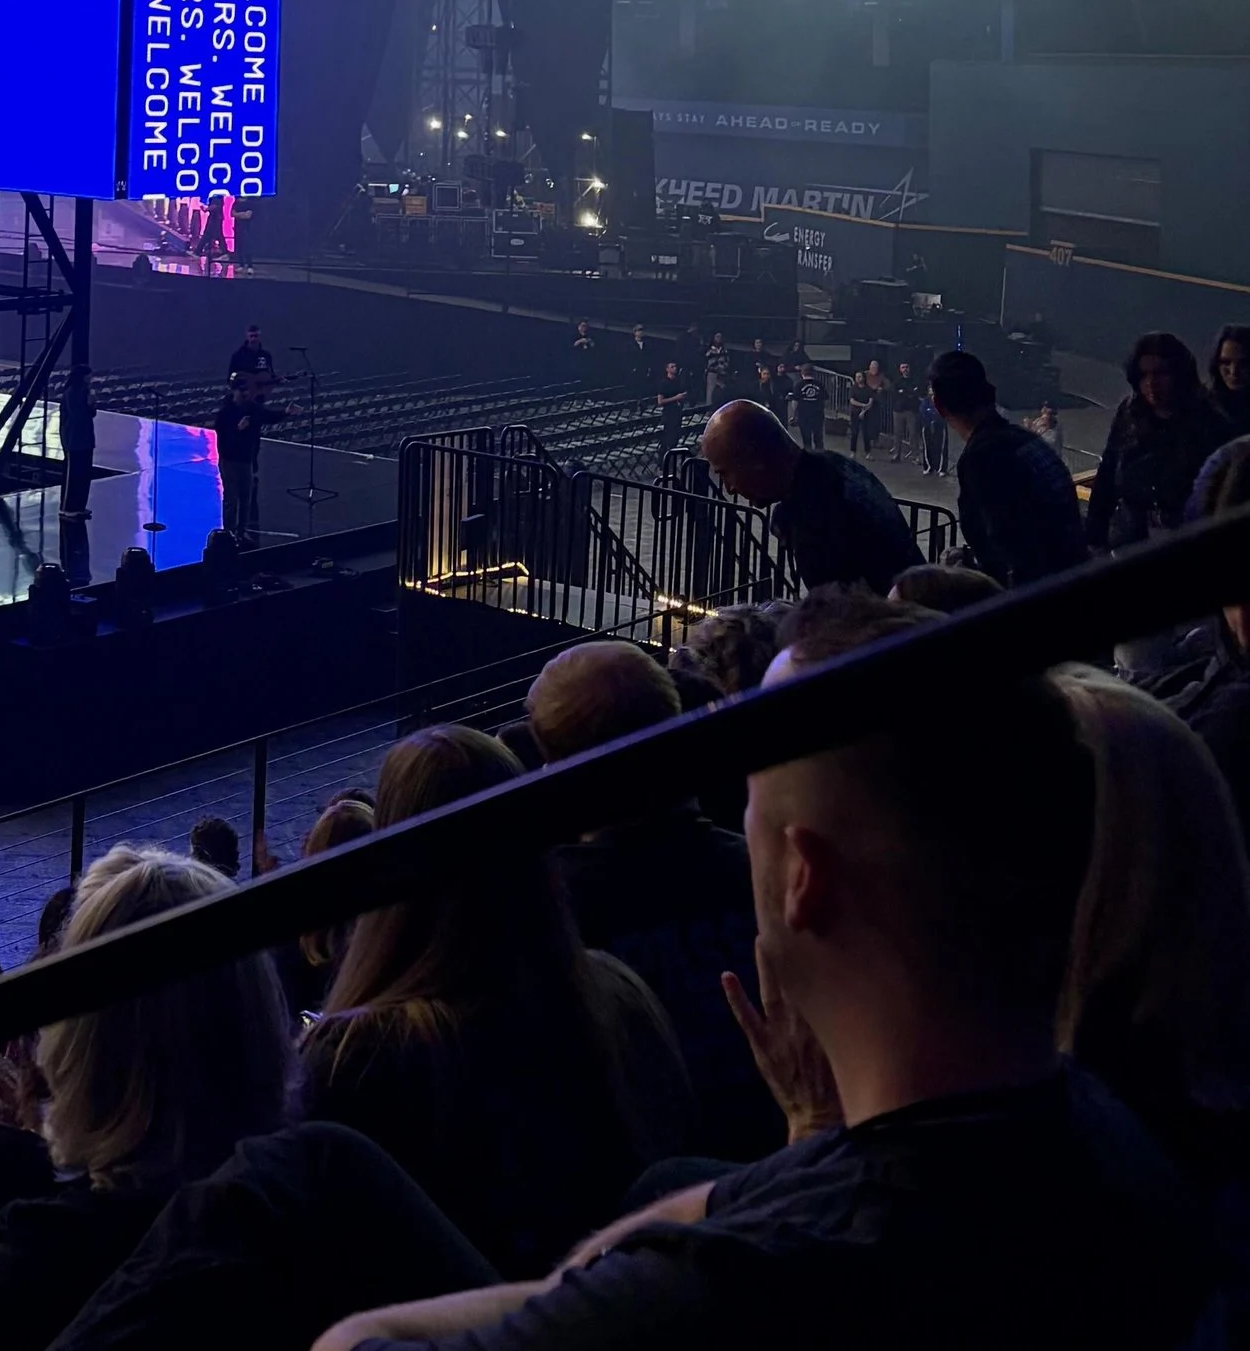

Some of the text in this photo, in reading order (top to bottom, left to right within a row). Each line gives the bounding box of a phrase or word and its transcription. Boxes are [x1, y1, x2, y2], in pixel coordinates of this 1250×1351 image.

[177, 64, 201, 191] WELCO
[677, 112, 705, 124] STAY
[715, 114, 788, 130] AHEAD
[804, 119, 880, 135] READY
[793, 226, 826, 248] ENERGY
[797, 249, 833, 272] RANSFER
[1049, 246, 1073, 268] 407
